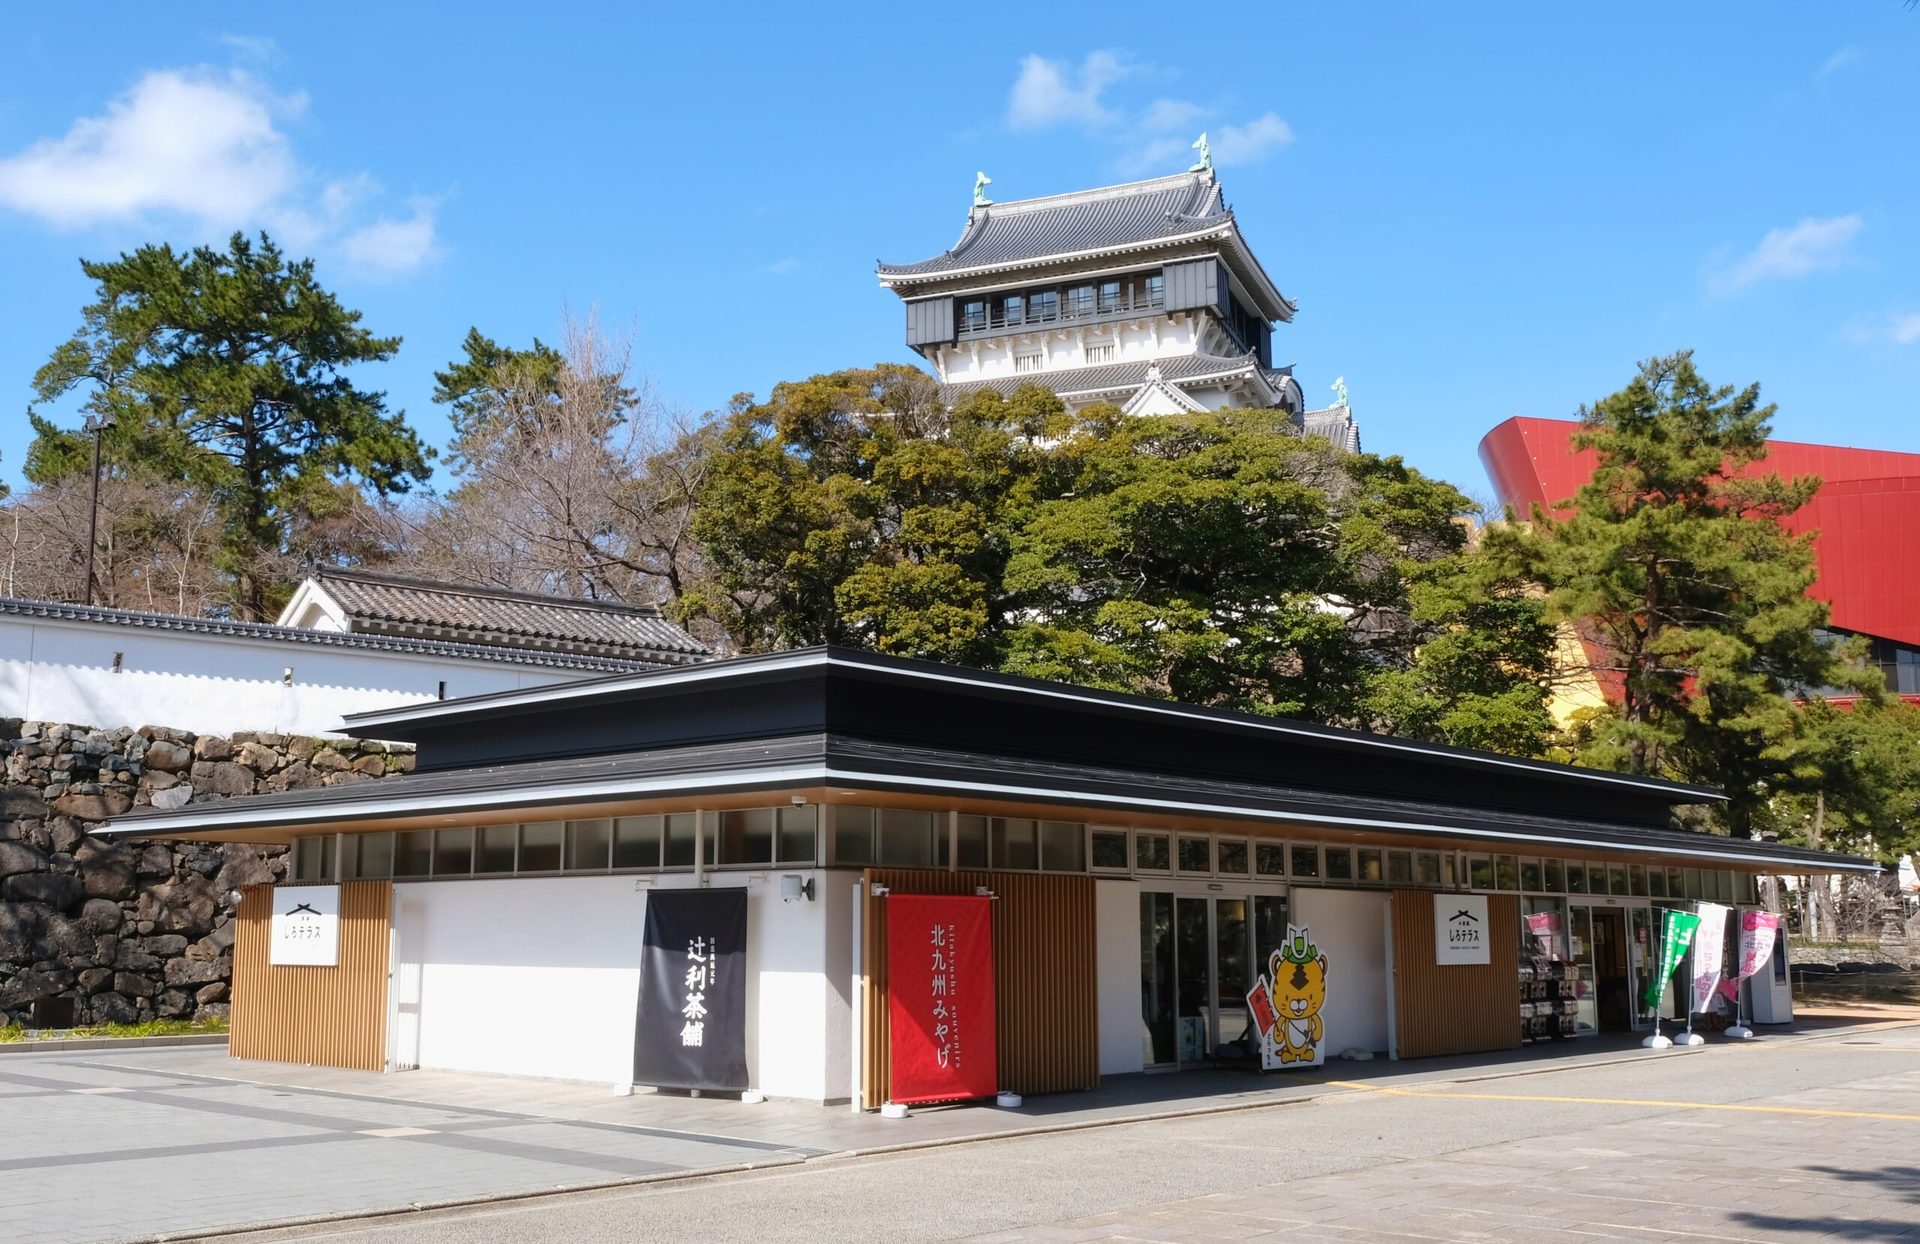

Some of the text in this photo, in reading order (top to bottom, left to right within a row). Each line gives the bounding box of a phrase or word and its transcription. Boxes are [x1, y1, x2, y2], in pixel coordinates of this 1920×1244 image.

[284, 926, 321, 939] しろテラス
[1449, 929, 1480, 942] しろテラス
[931, 924, 951, 1068] 北九州みやげ
[949, 925, 962, 1068] Kitakyushu souvenirs
